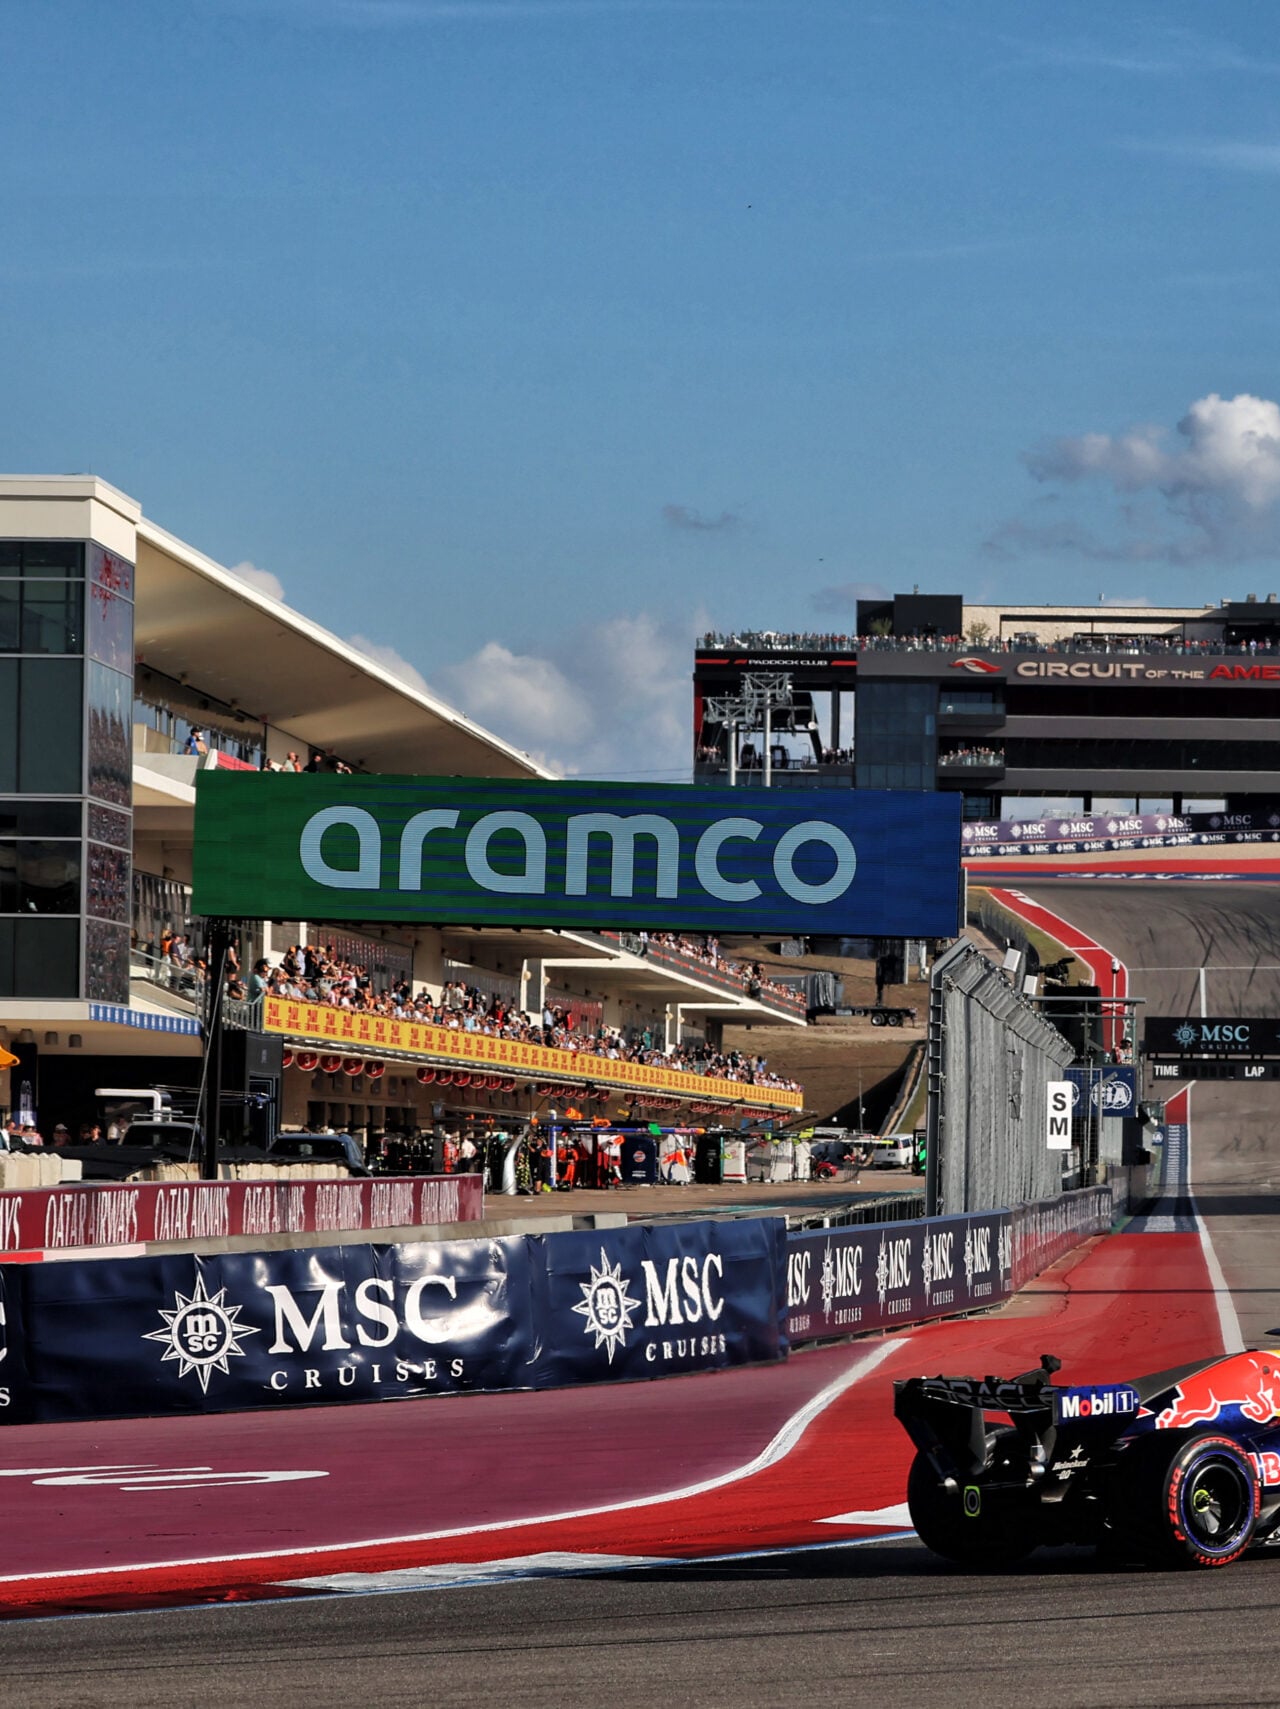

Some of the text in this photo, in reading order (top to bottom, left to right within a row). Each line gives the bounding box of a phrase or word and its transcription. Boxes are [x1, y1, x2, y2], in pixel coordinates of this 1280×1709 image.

[1016, 662, 1145, 678] CIRCUIT
[1145, 669, 1168, 680] OF
[1171, 669, 1204, 680] THE
[1022, 824, 1046, 835] MSC
[1070, 822, 1094, 833] MSC
[1119, 820, 1143, 831] MSC
[1168, 817, 1192, 828] MSC
[1223, 815, 1251, 826] MSC
[975, 826, 998, 837] MSC
[300, 805, 857, 904] aramco
[1200, 1025, 1250, 1042] MSC
[1200, 1043, 1250, 1051] CRUISES
[304, 1054, 311, 1067] 3
[1154, 1065, 1179, 1077] TIME
[1244, 1066, 1265, 1078] LAP
[932, 1232, 953, 1281] MSC
[973, 1226, 991, 1274] MSC
[835, 1245, 862, 1298] MSC
[887, 1238, 911, 1290] MSC
[641, 1253, 724, 1327] MSC
[264, 1275, 457, 1354] MSC
[645, 1333, 727, 1362] CRUISES
[270, 1358, 464, 1391] CRUISES
[1062, 1393, 1113, 1418] Mobil
[1168, 1466, 1183, 1526] ZERO
